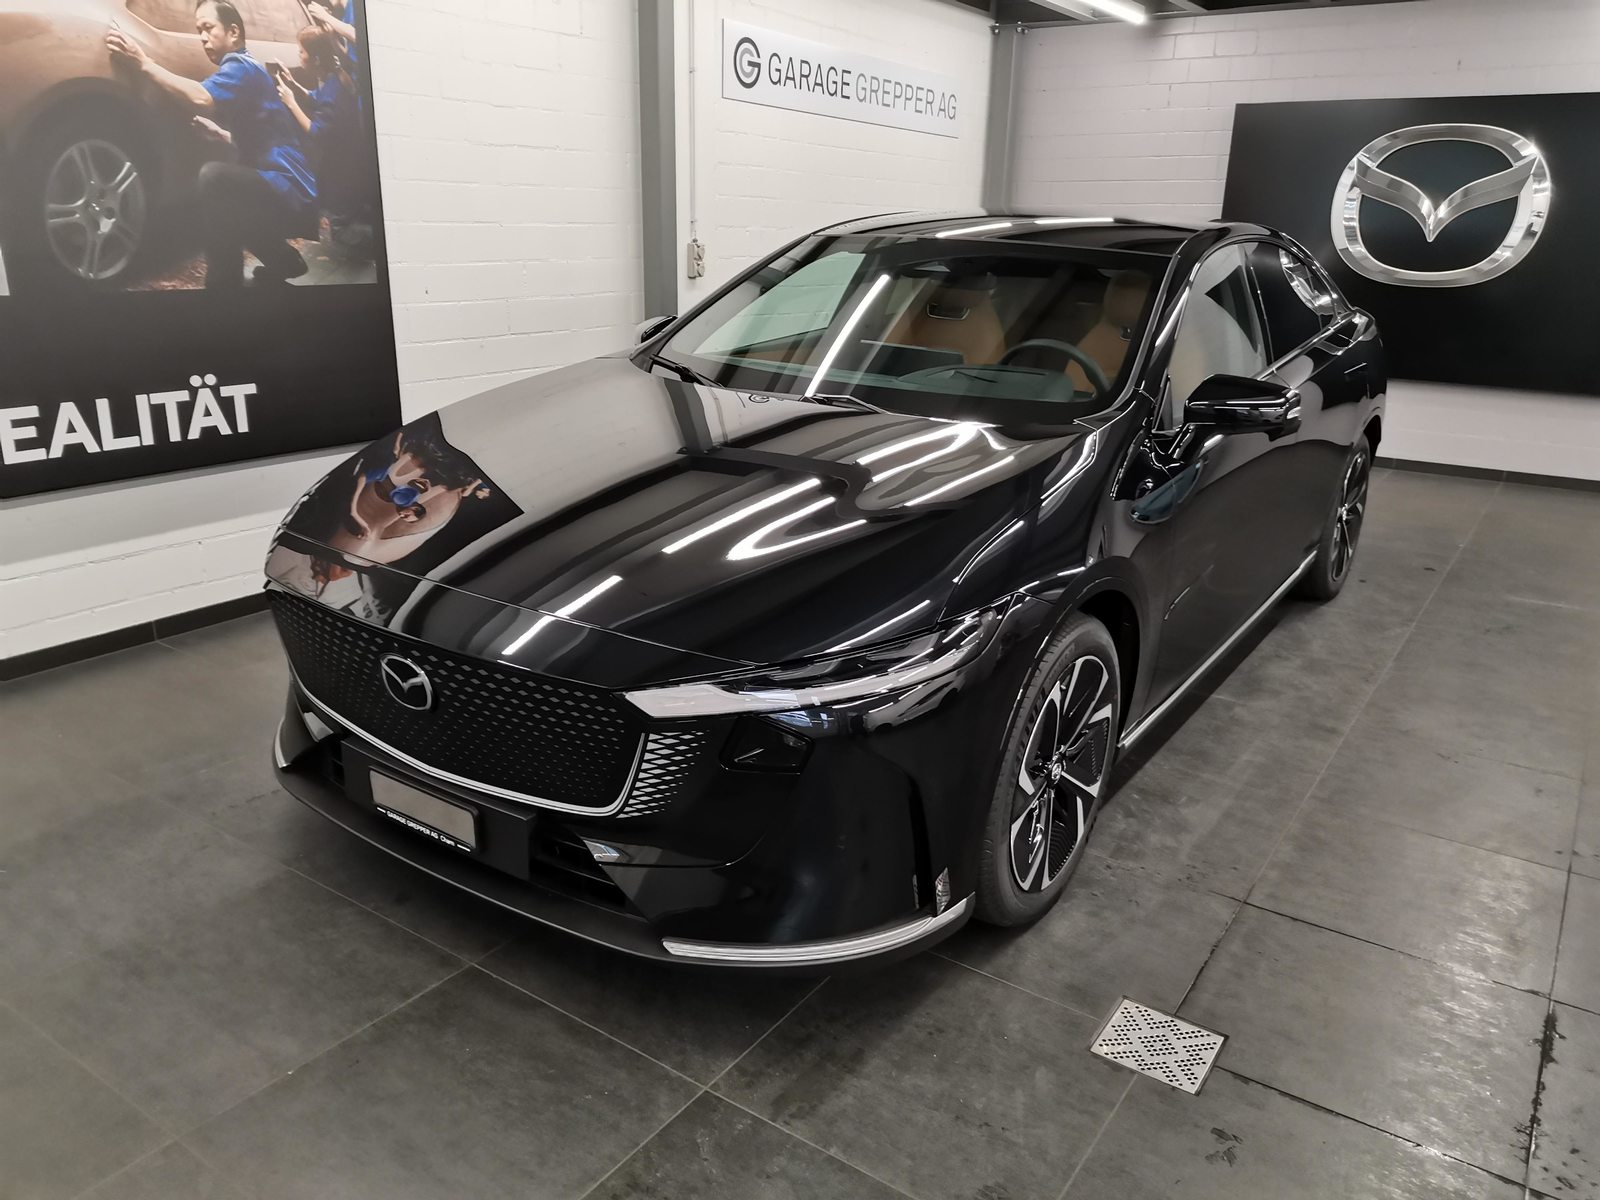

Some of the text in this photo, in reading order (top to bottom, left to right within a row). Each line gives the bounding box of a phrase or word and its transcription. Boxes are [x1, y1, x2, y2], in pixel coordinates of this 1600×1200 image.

[768, 52, 851, 100] GARAGE
[855, 73, 934, 118] GREPPER
[936, 92, 957, 120] AG
[0, 373, 257, 465] EALITÄT
